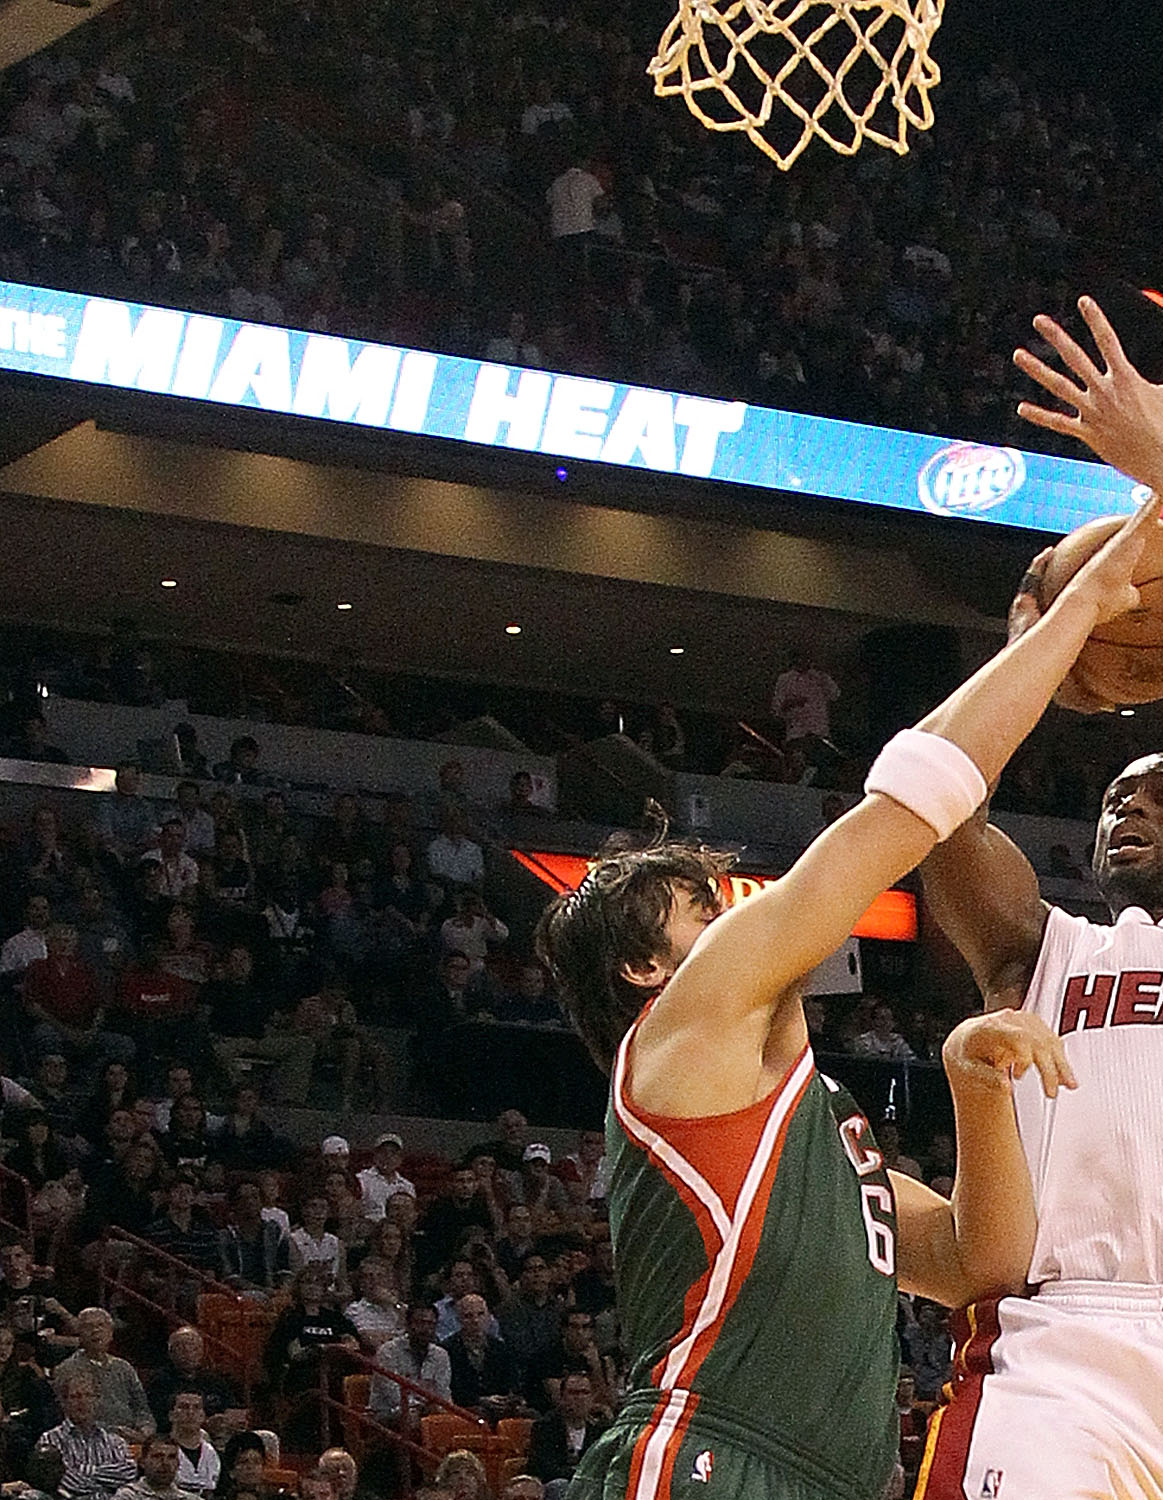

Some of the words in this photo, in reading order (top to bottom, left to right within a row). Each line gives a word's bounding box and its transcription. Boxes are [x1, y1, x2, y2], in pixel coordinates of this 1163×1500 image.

[70, 299, 437, 432] MIAMI
[465, 365, 747, 478] HEAT
[861, 1183, 896, 1277] 6
